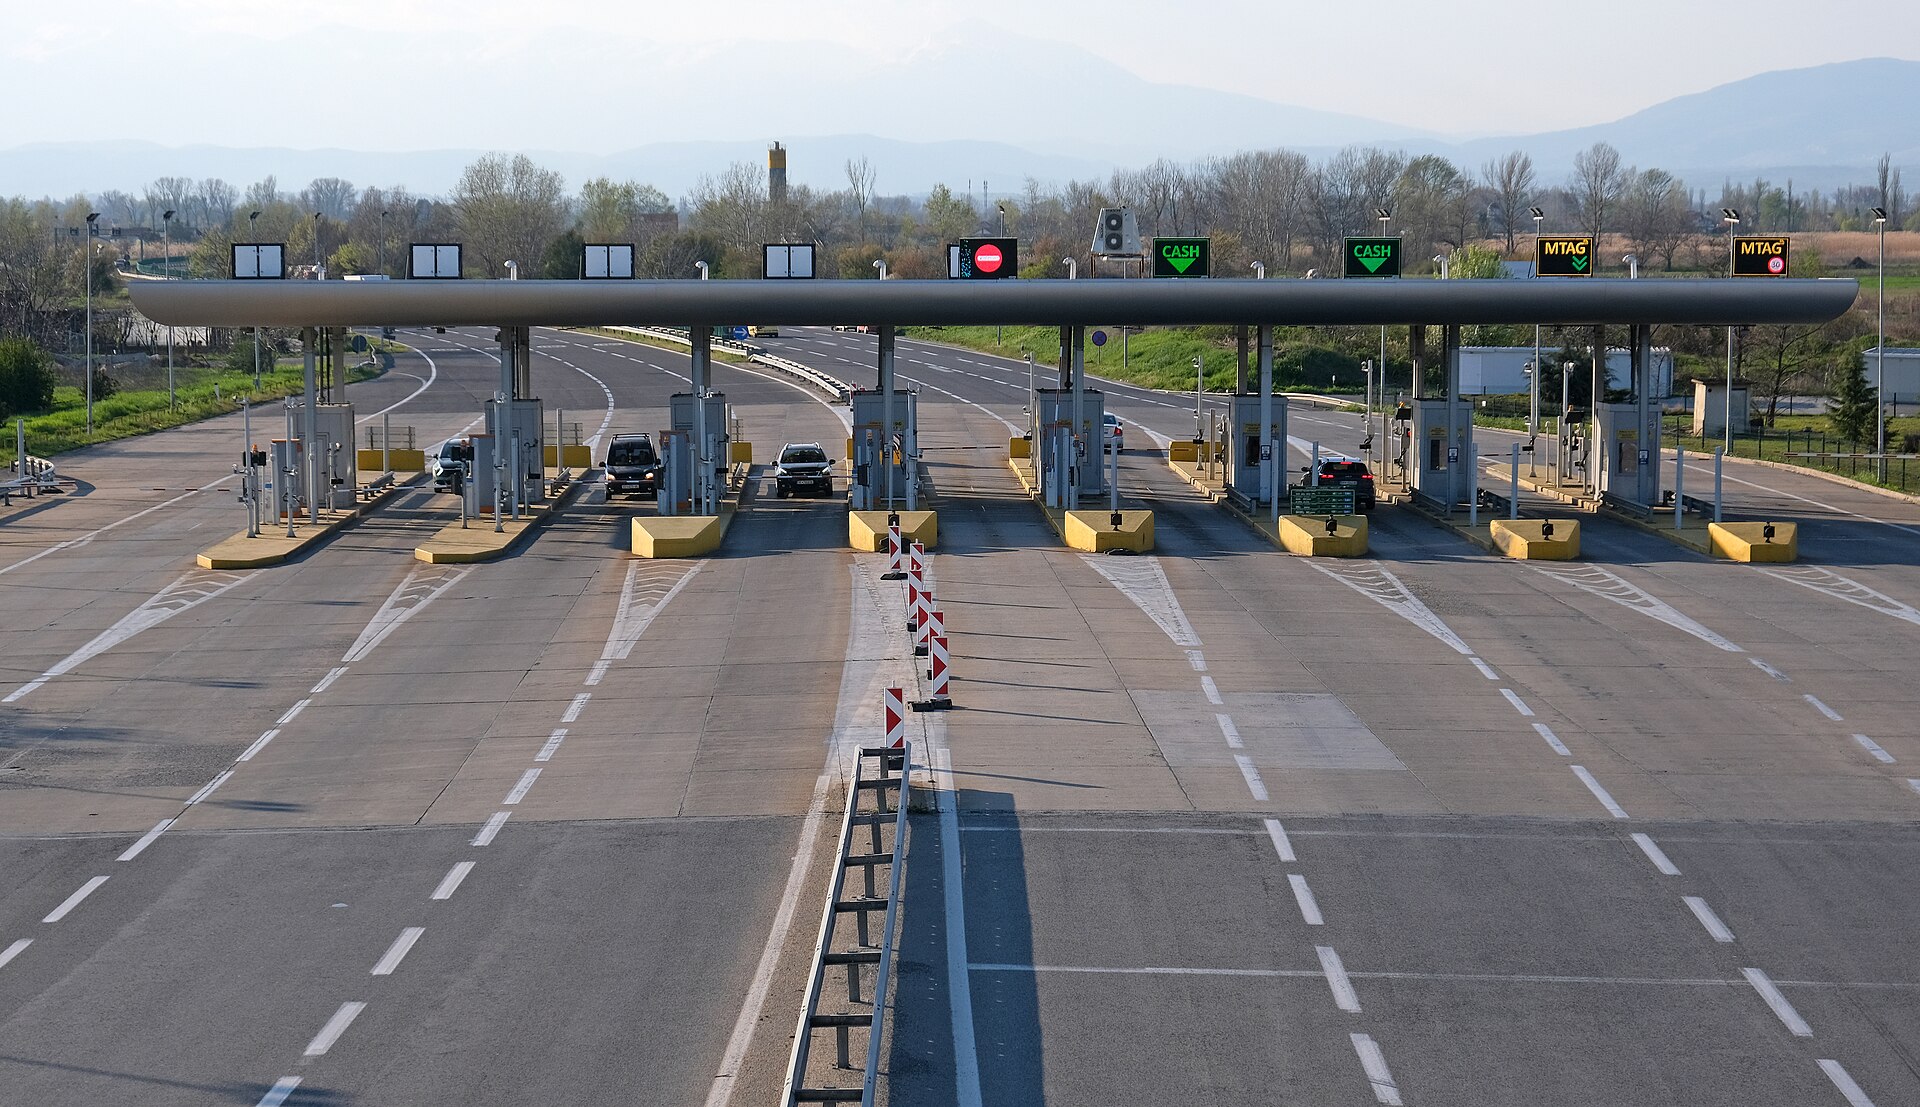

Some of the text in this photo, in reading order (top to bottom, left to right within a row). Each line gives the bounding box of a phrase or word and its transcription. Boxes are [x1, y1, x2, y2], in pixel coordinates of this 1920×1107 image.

[1162, 245, 1200, 258] CASH
[1353, 245, 1391, 257] CASH
[1545, 241, 1586, 255] MTAG
[1741, 241, 1782, 255] MTAG
